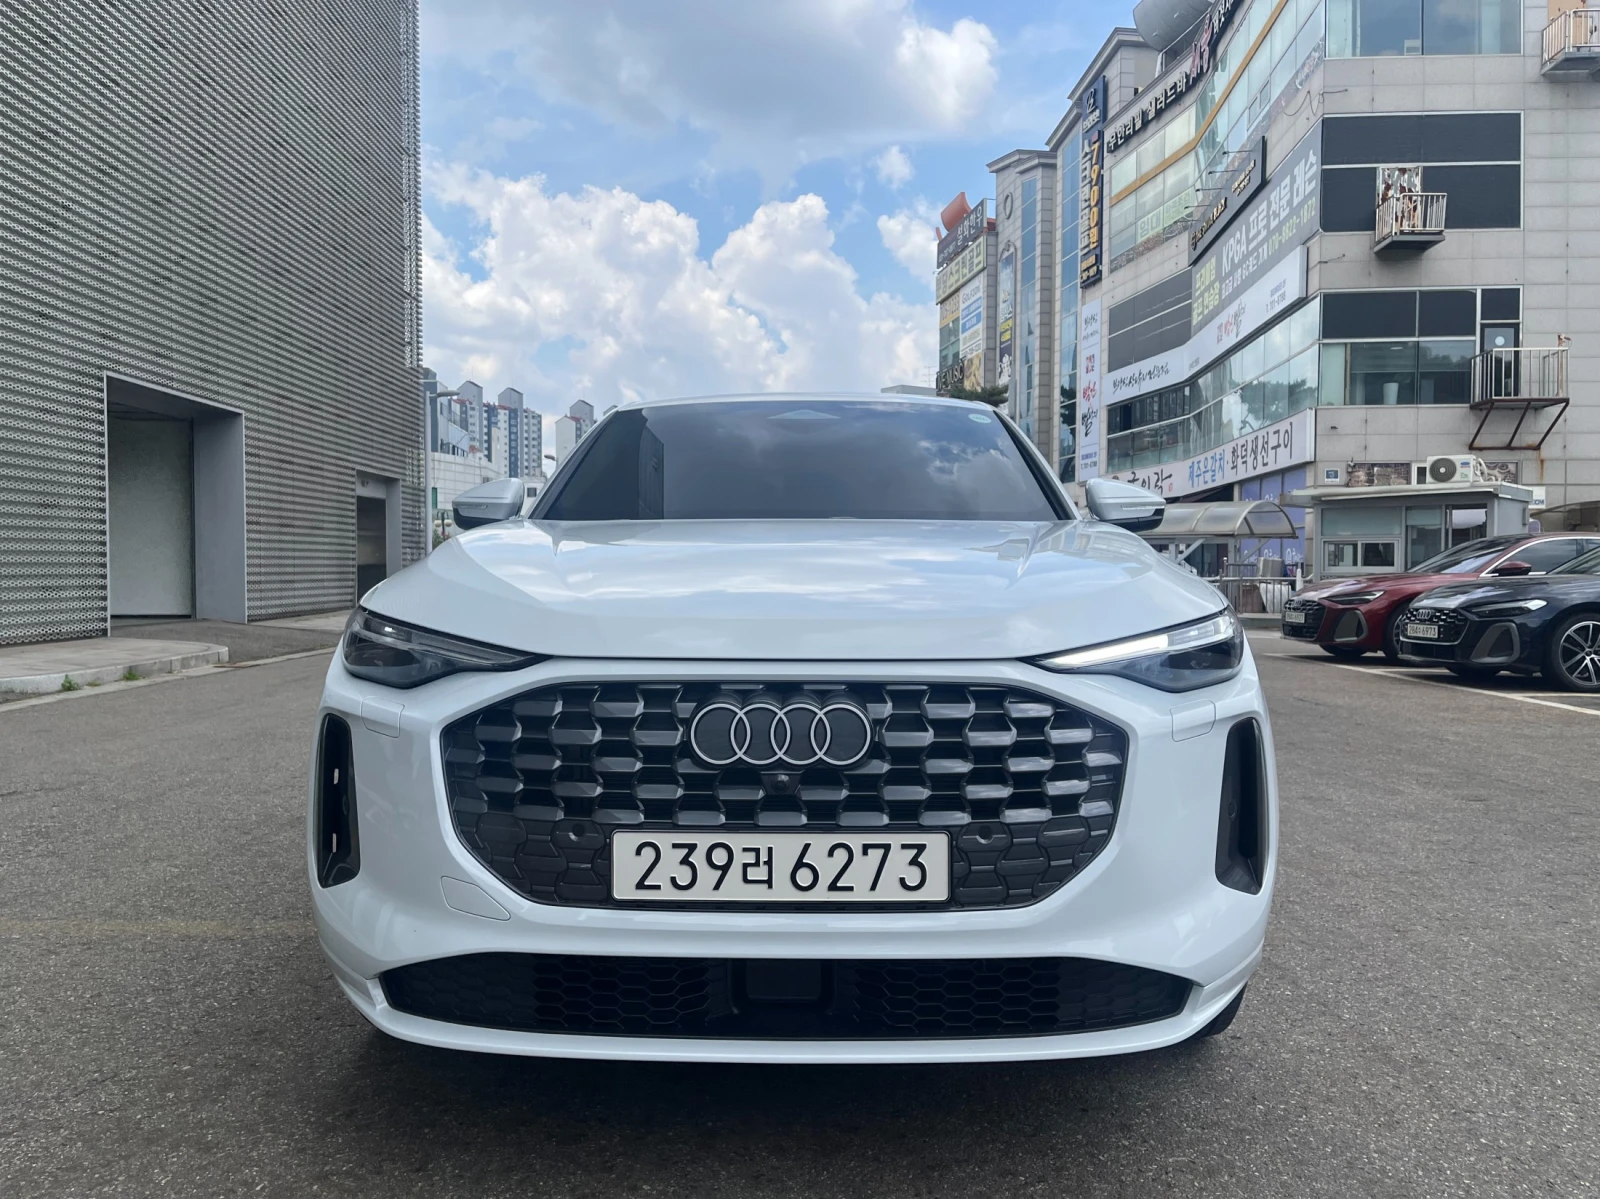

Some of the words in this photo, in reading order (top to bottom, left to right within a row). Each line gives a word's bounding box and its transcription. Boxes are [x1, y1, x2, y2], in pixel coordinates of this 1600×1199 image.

[1080, 138, 1091, 256] 스크린골프
[1090, 141, 1100, 250] 7900원
[1222, 225, 1247, 276] KPGA
[1249, 200, 1267, 250] 프로
[1270, 175, 1290, 229] 전문
[1293, 149, 1317, 207] 레슨
[635, 841, 774, 892] 239러
[789, 842, 928, 892] 6273
